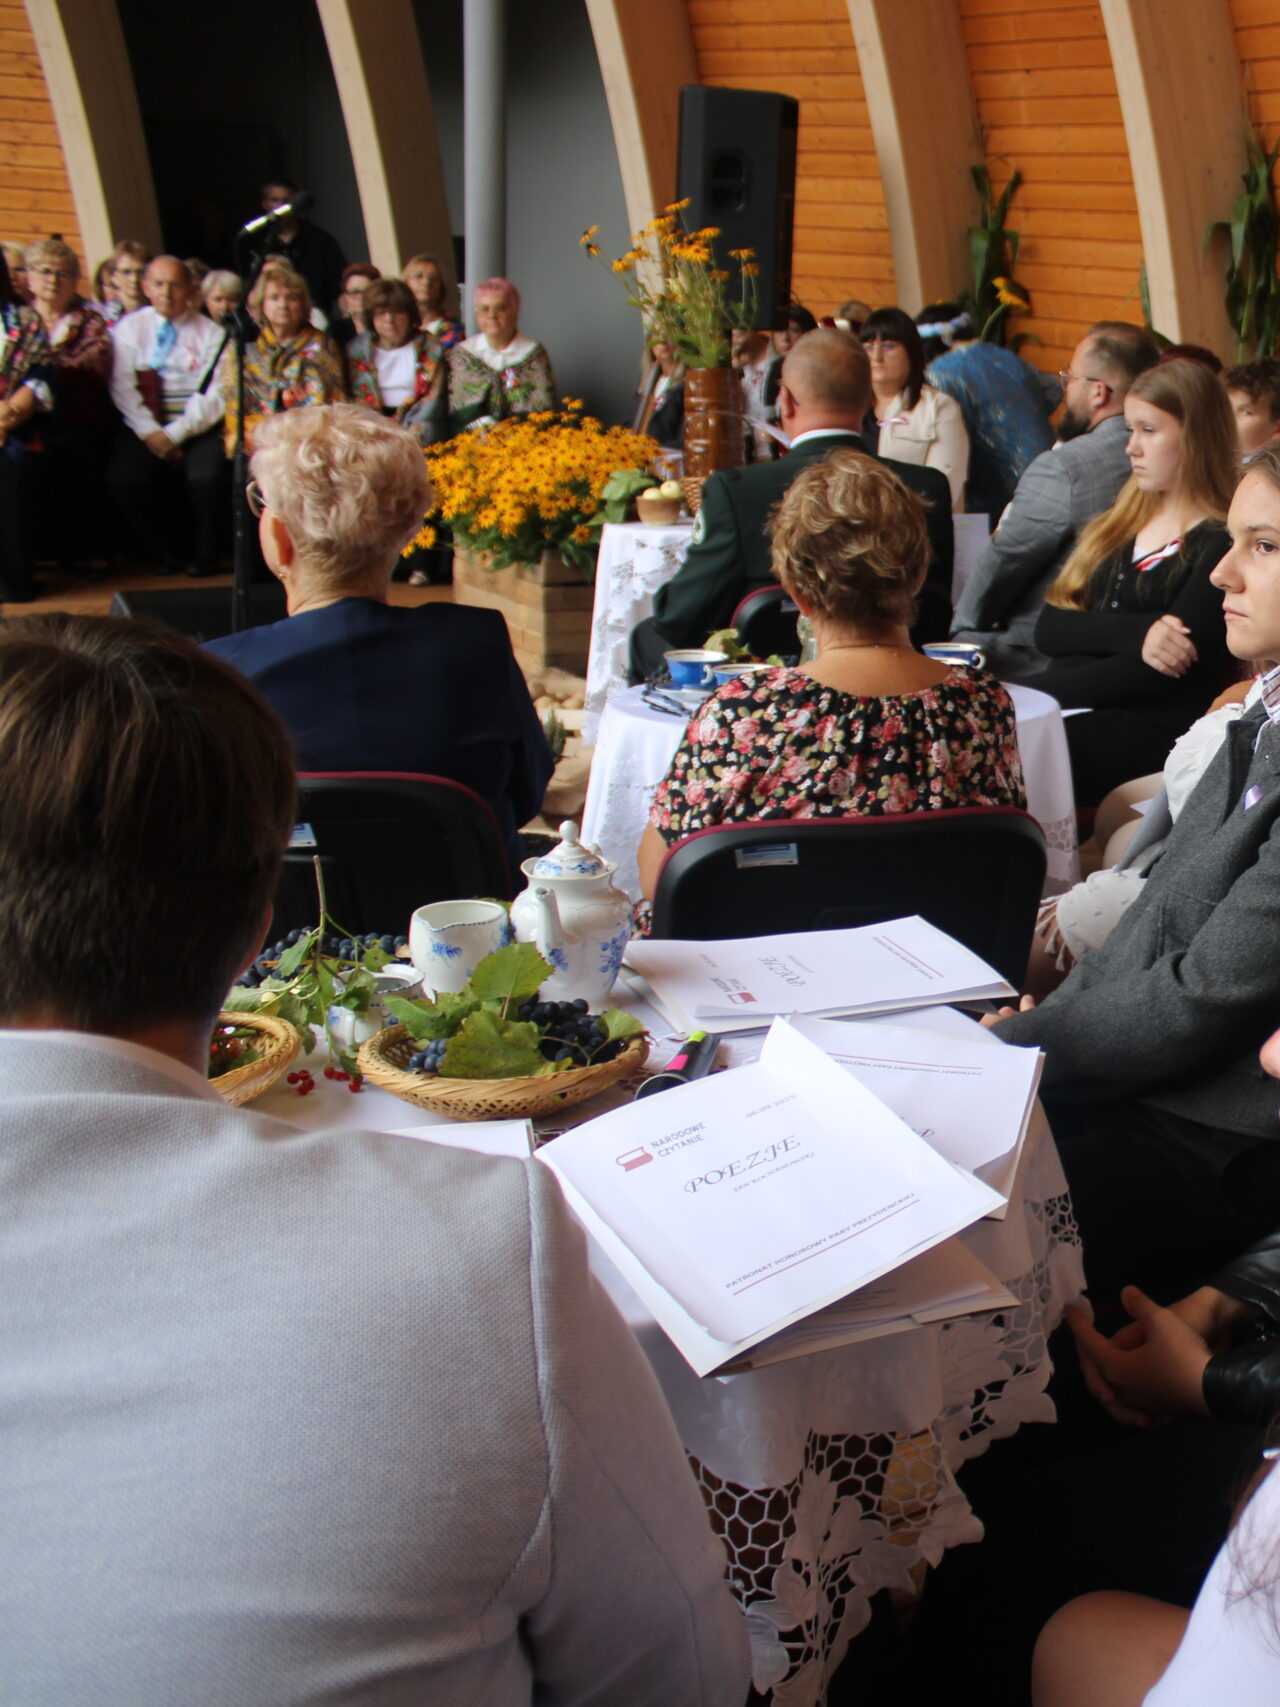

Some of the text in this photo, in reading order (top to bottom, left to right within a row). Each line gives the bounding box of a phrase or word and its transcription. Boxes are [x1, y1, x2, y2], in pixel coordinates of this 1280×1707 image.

[651, 1121, 707, 1149] NARODOWE
[658, 1134, 705, 1158] CZYTANIE
[683, 1134, 801, 1194] POEZJE
[725, 1262, 773, 1289] PATRONAT
[774, 1237, 828, 1265] HONOROWY
[828, 1225, 851, 1240] PARY
